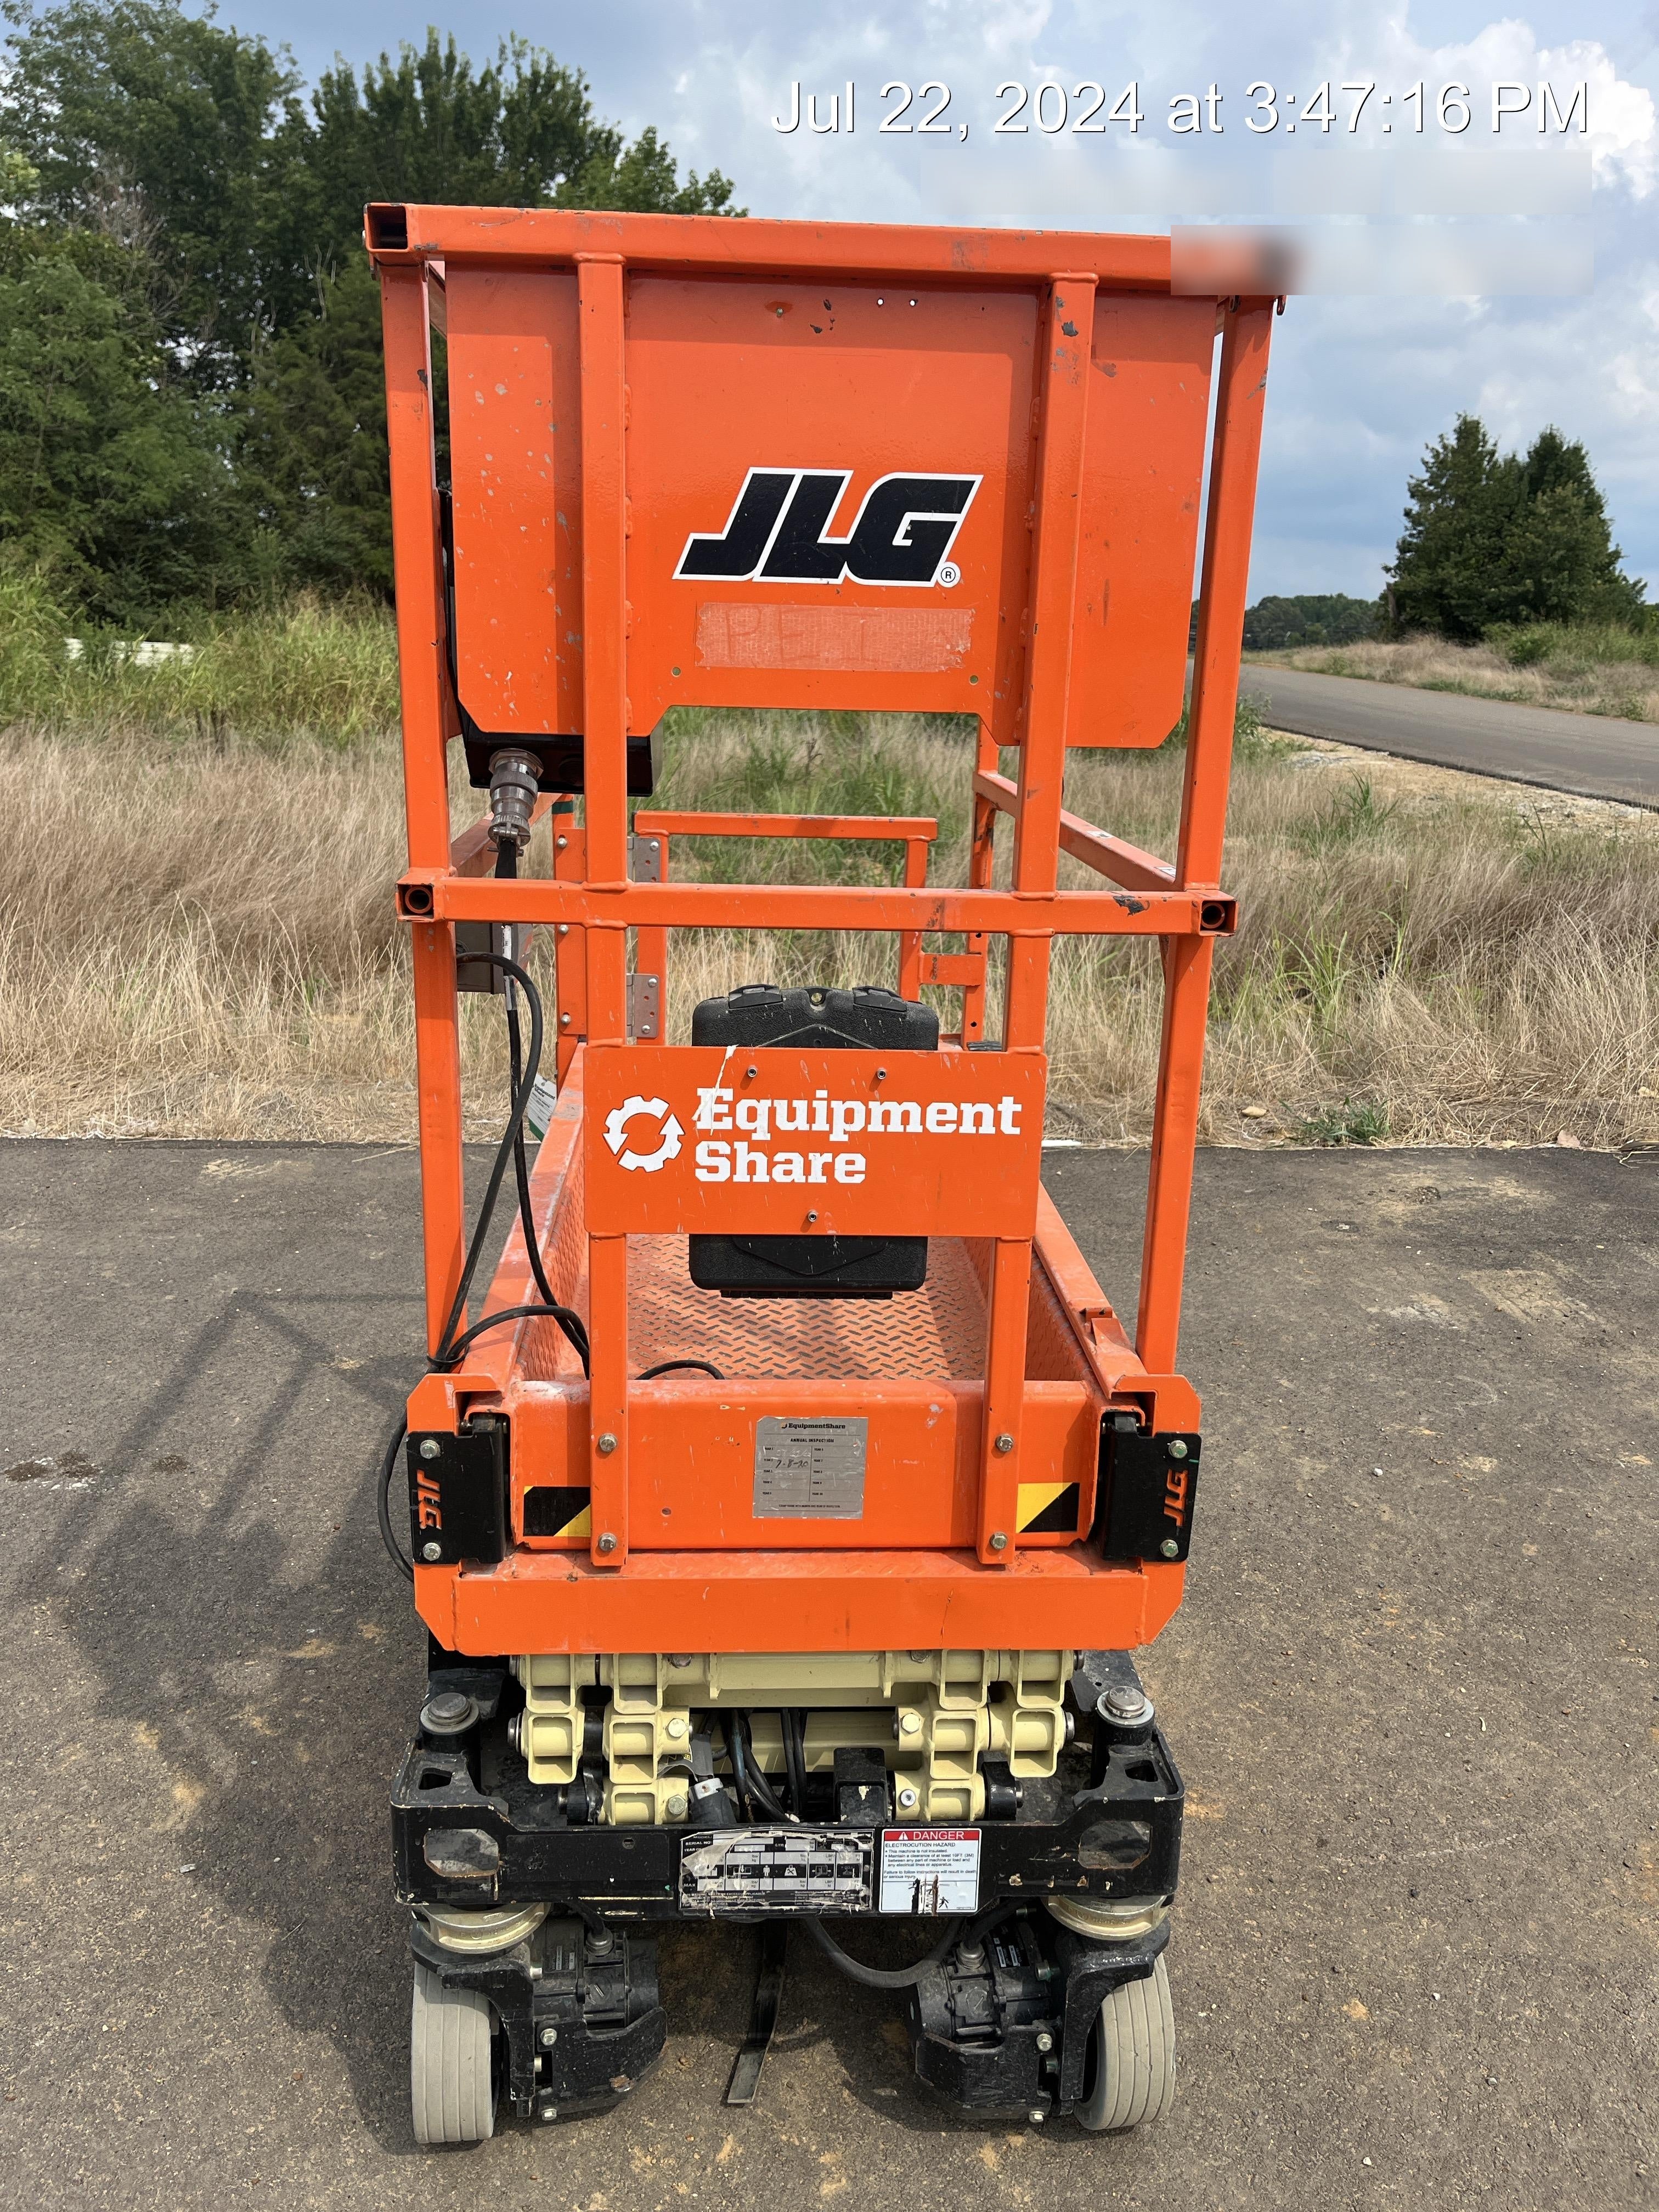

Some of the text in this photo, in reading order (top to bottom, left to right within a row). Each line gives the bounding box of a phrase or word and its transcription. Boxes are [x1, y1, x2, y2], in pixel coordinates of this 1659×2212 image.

[672, 467, 984, 588] JLG
[694, 1087, 1022, 1142] Equipment
[695, 1141, 866, 1184] Share
[416, 1468, 442, 1530] JLG
[1163, 1469, 1189, 1527] JLG
[913, 1831, 964, 1840] DANGER
